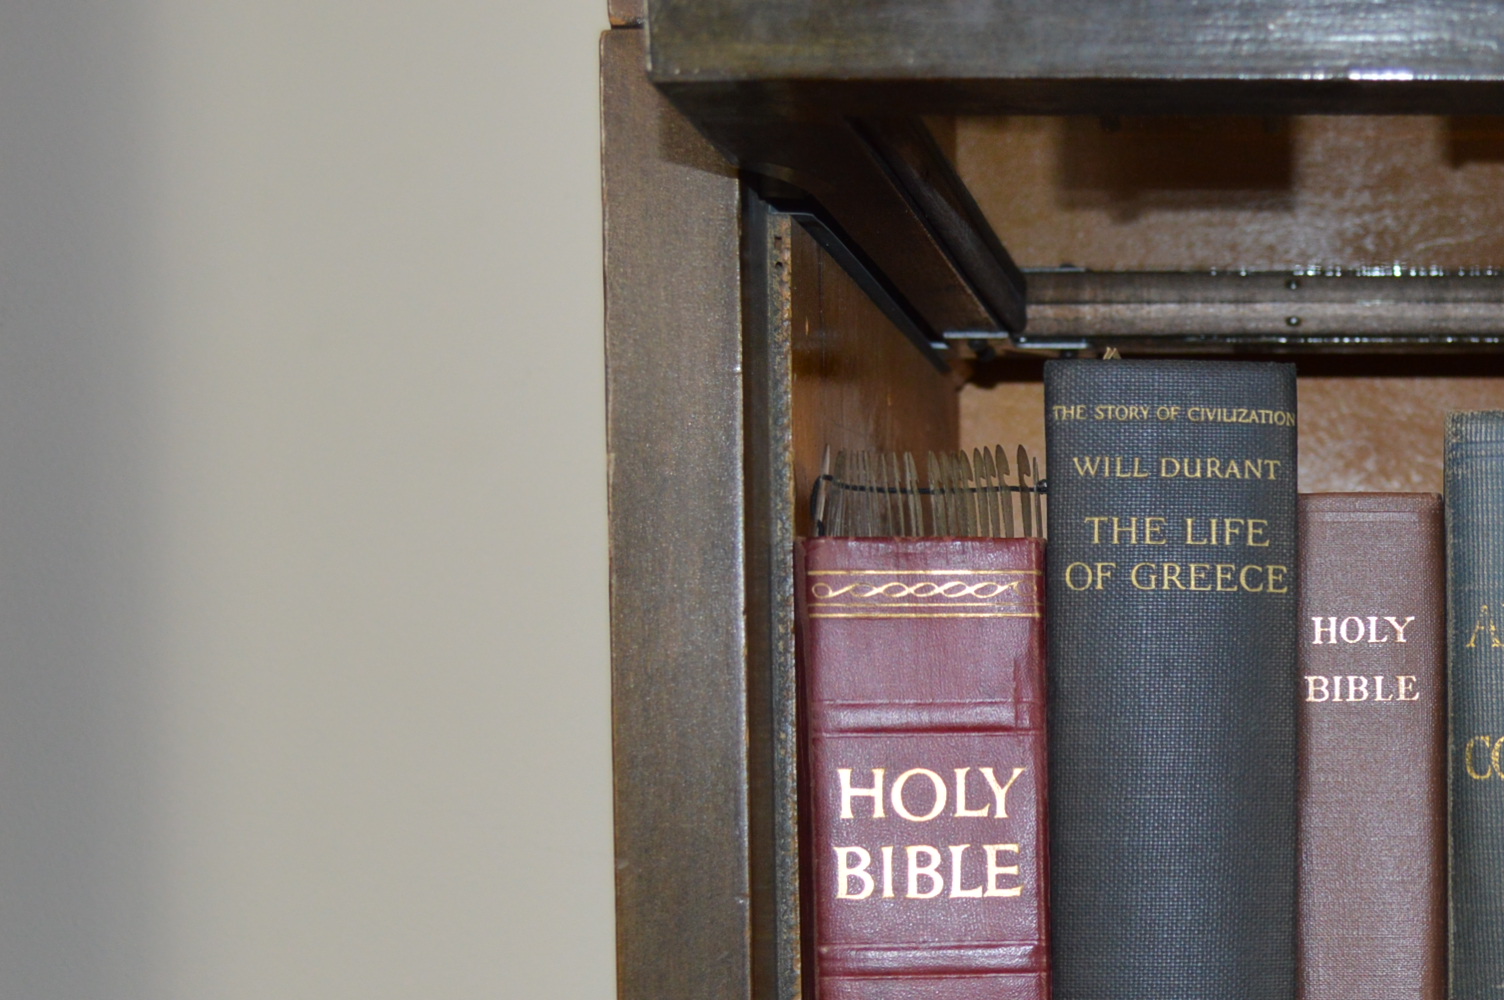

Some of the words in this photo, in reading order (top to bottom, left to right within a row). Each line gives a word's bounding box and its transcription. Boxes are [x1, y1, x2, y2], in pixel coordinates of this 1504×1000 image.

[1053, 405, 1086, 421] THE
[1094, 405, 1150, 421] STORY
[1157, 406, 1181, 421] OF
[1188, 406, 1296, 427] CIVILIZATION
[1073, 456, 1149, 478] WILL
[1161, 457, 1281, 480] DURANT
[1084, 516, 1167, 545] THE
[1185, 517, 1270, 547] LIFE
[1064, 561, 1116, 591] OF
[1131, 563, 1289, 594] GREECE
[1312, 616, 1415, 645] HOLY
[1304, 674, 1420, 703] BIBLE
[837, 767, 1026, 822] HOLY
[833, 844, 1025, 900] BIBLE
